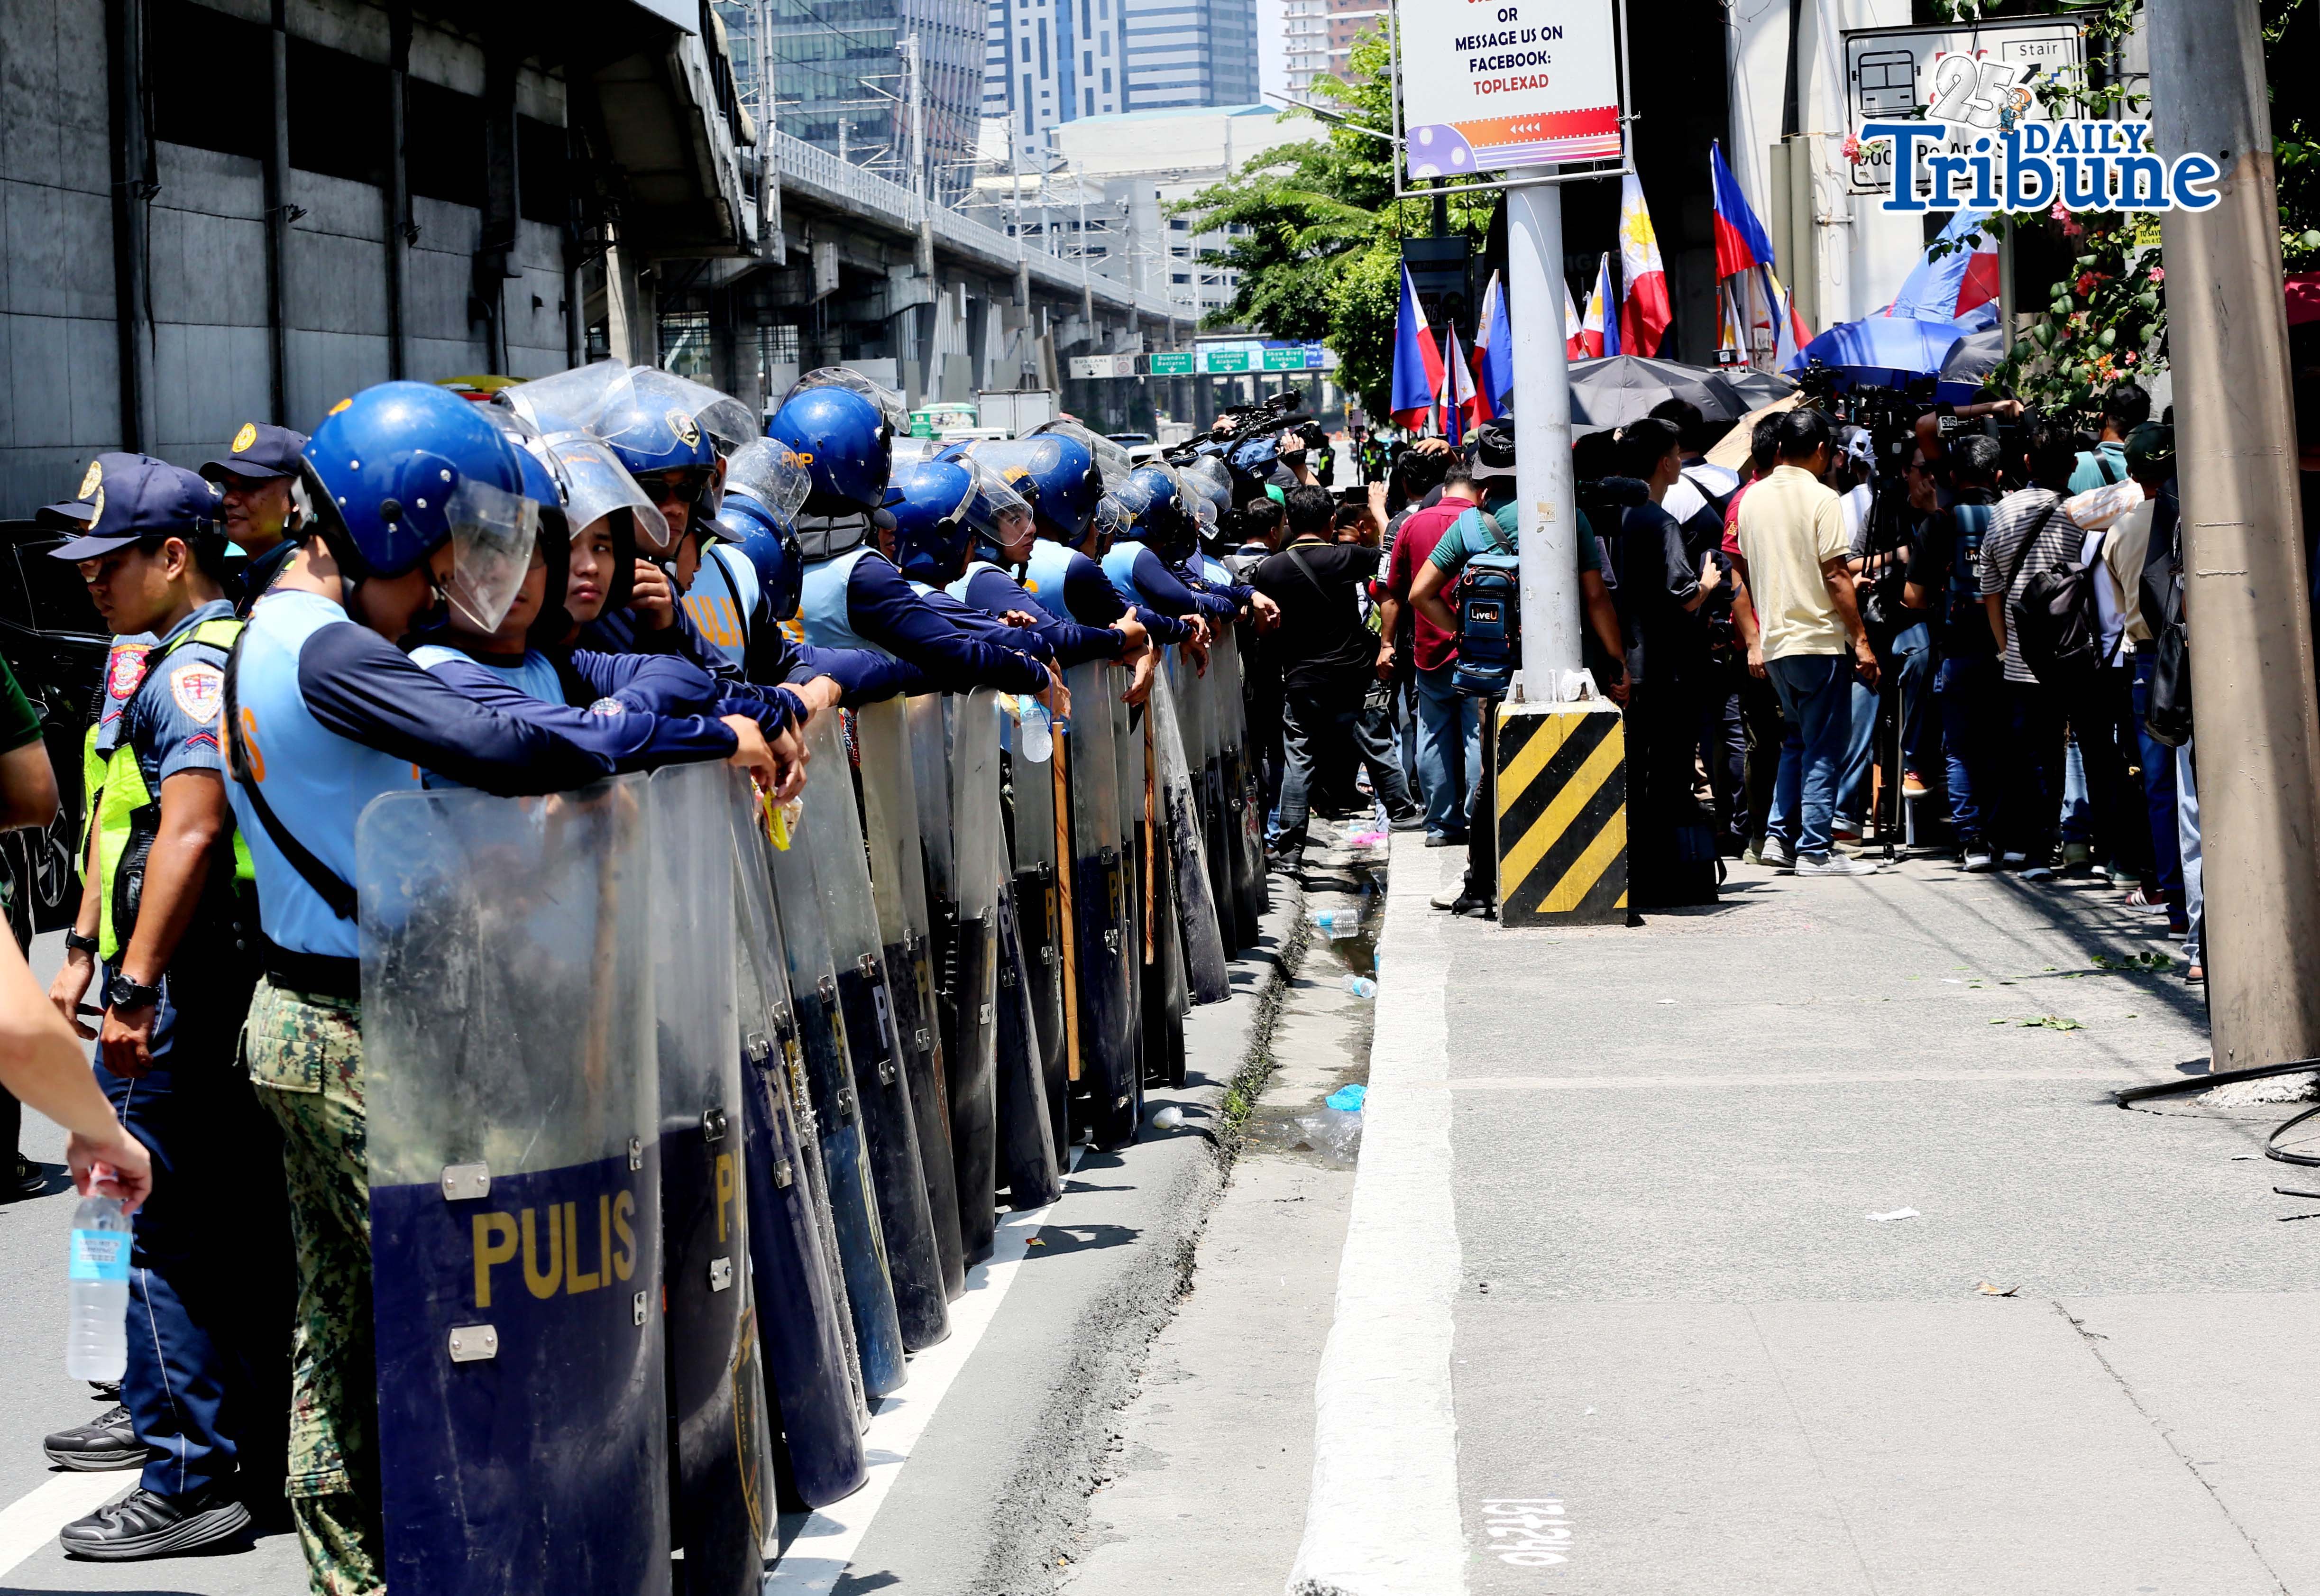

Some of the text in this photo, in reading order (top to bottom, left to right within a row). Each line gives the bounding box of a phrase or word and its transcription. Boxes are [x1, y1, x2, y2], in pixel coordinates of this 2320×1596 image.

[1497, 8, 1518, 23] OR
[1455, 25, 1563, 51] MESSAGE US ON
[2020, 42, 2058, 56] Stair
[1469, 50, 1551, 73] FACEBOOK:
[1474, 74, 1549, 95] TOPLEXAD
[781, 451, 814, 469] PNP
[1472, 608, 1497, 620] LiveU
[472, 1189, 636, 1308] PULIS
